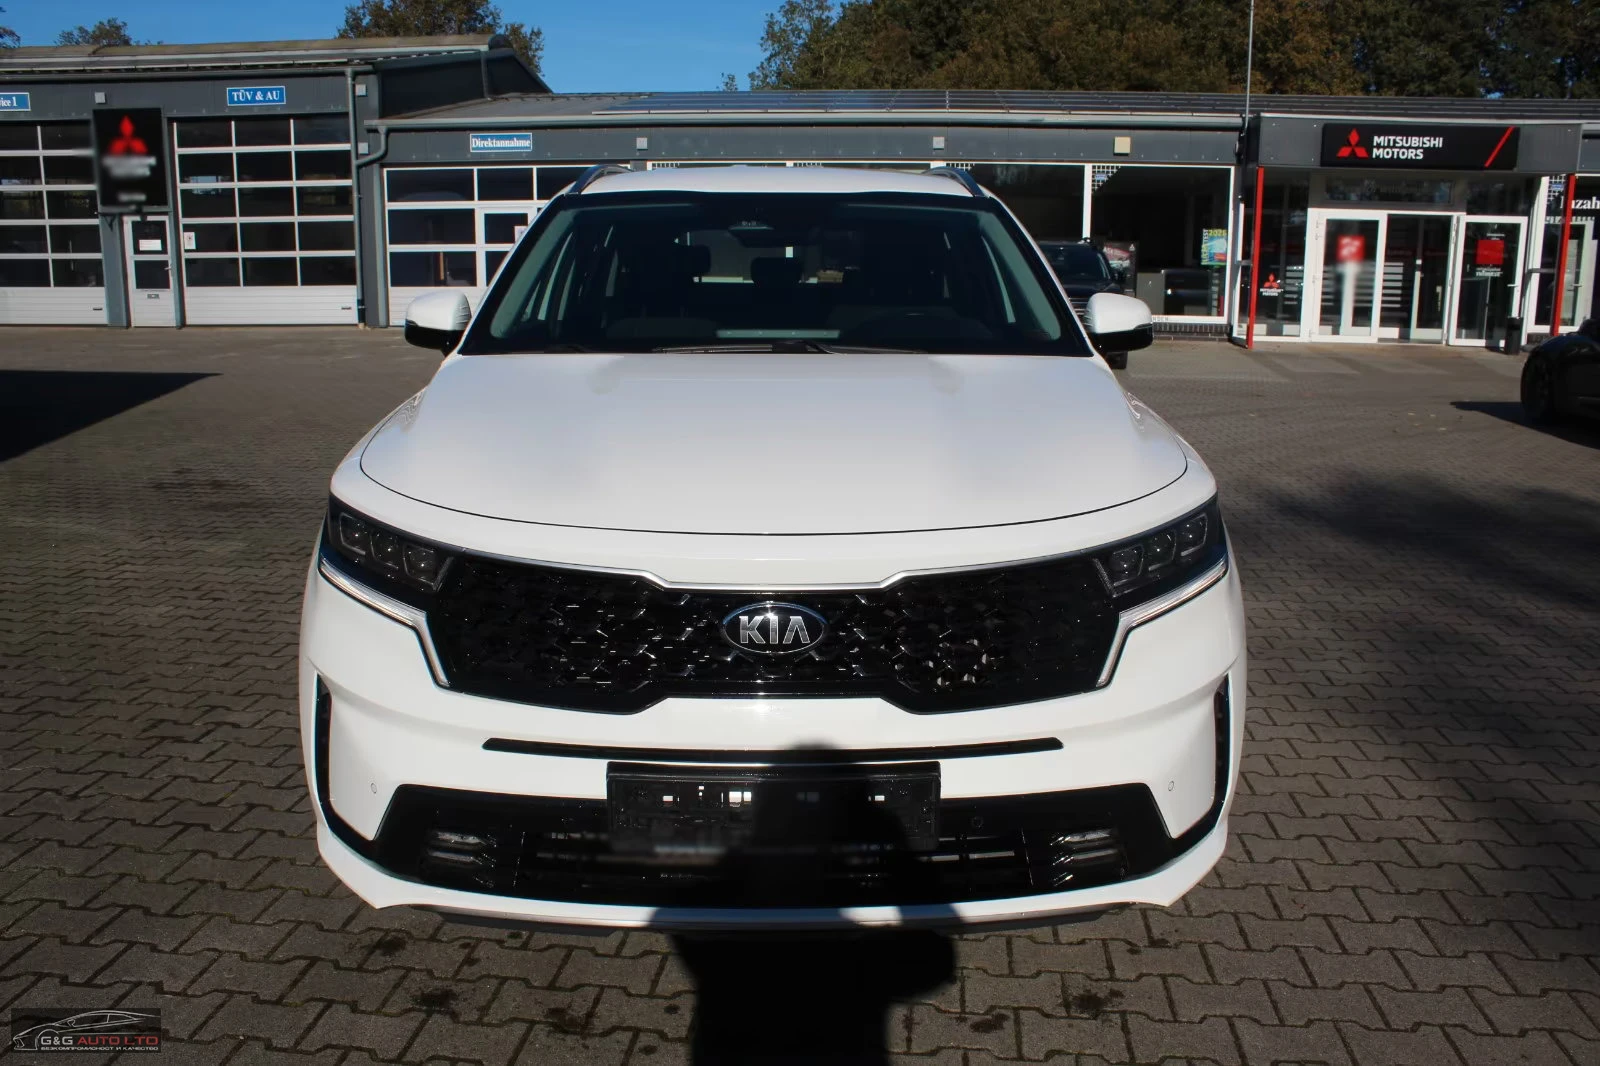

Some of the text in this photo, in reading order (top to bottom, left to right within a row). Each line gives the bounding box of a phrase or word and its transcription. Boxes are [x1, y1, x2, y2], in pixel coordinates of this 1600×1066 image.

[232, 90, 280, 102] TÜV & AU
[471, 137, 531, 148] Direktannahme
[1373, 135, 1444, 148] MITSUBISHI
[1372, 147, 1424, 160] MOTORS
[739, 615, 811, 644] KIA
